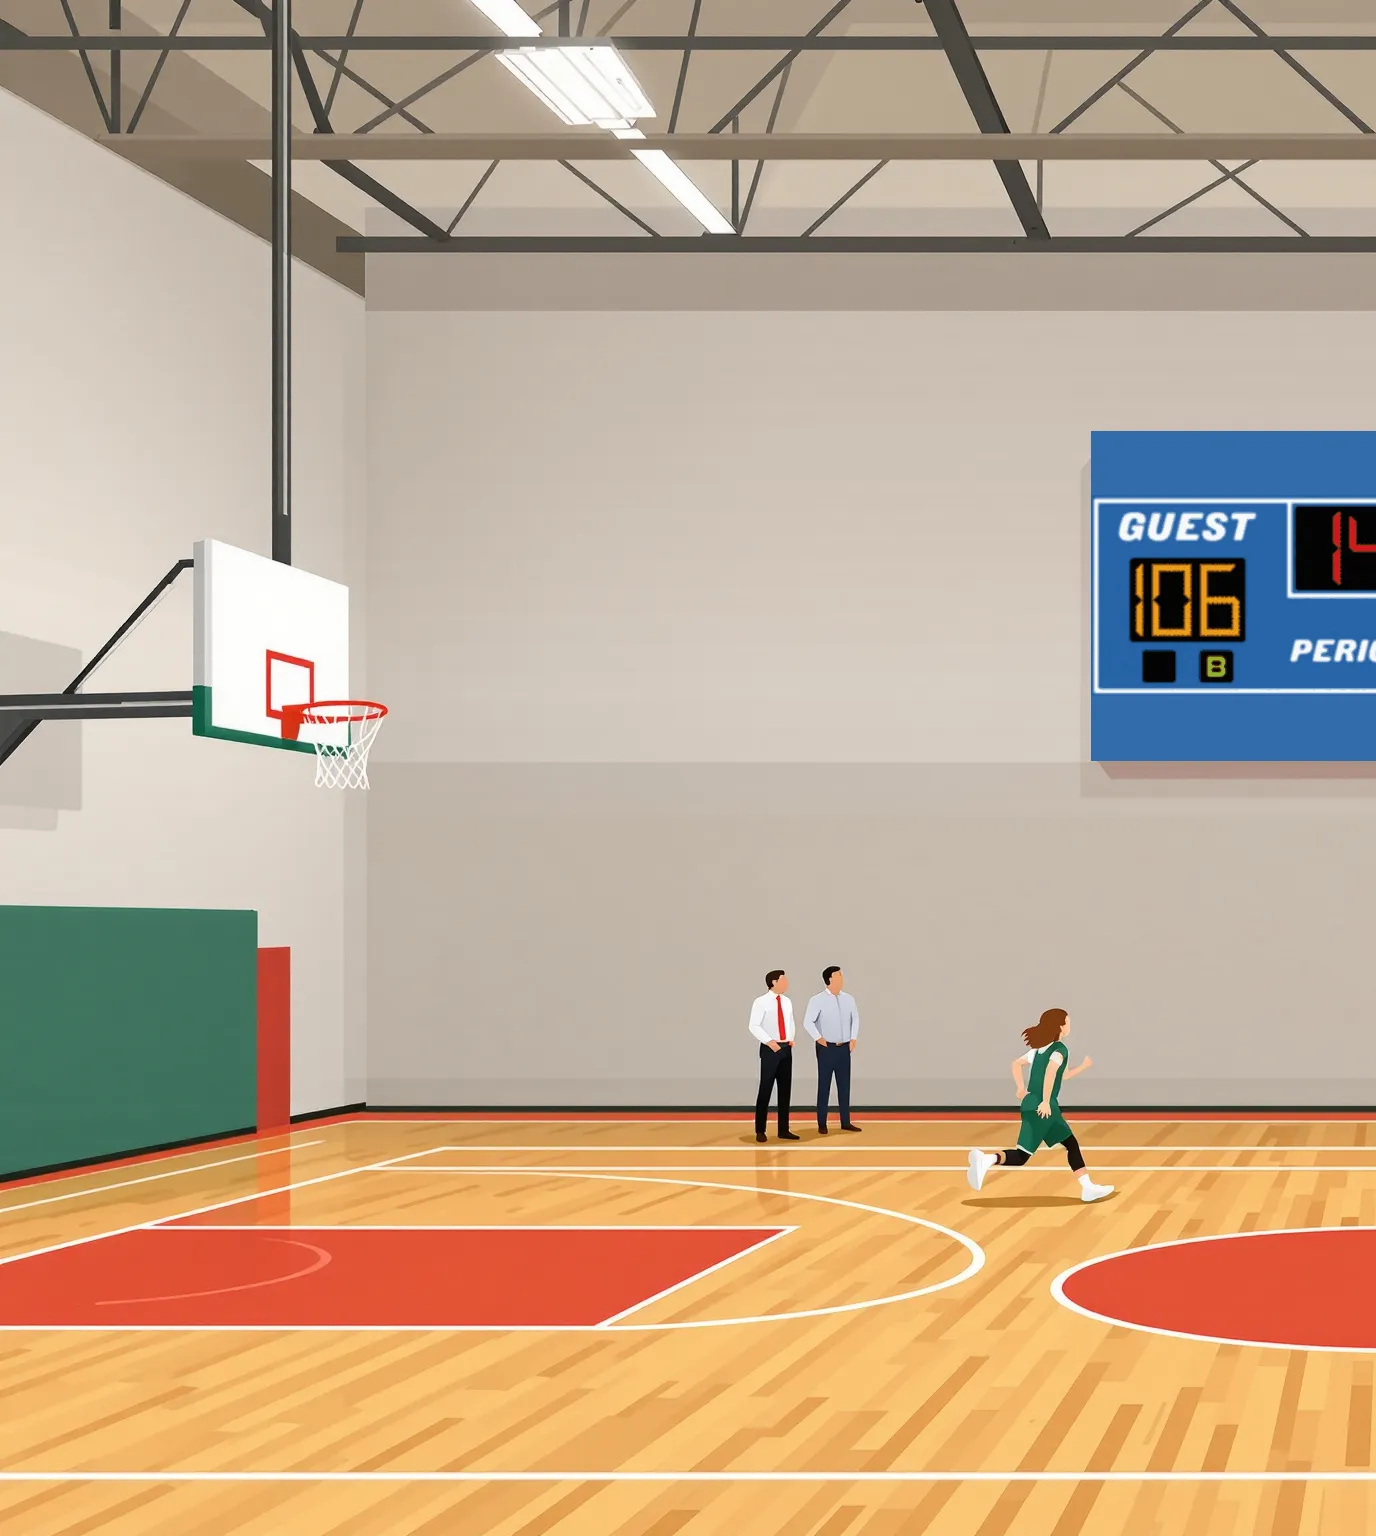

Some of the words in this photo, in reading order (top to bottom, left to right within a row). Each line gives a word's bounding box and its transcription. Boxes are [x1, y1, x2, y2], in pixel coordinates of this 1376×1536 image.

[1118, 512, 1257, 542] GUEST
[1135, 563, 1241, 637] 106
[1206, 656, 1227, 678] B
